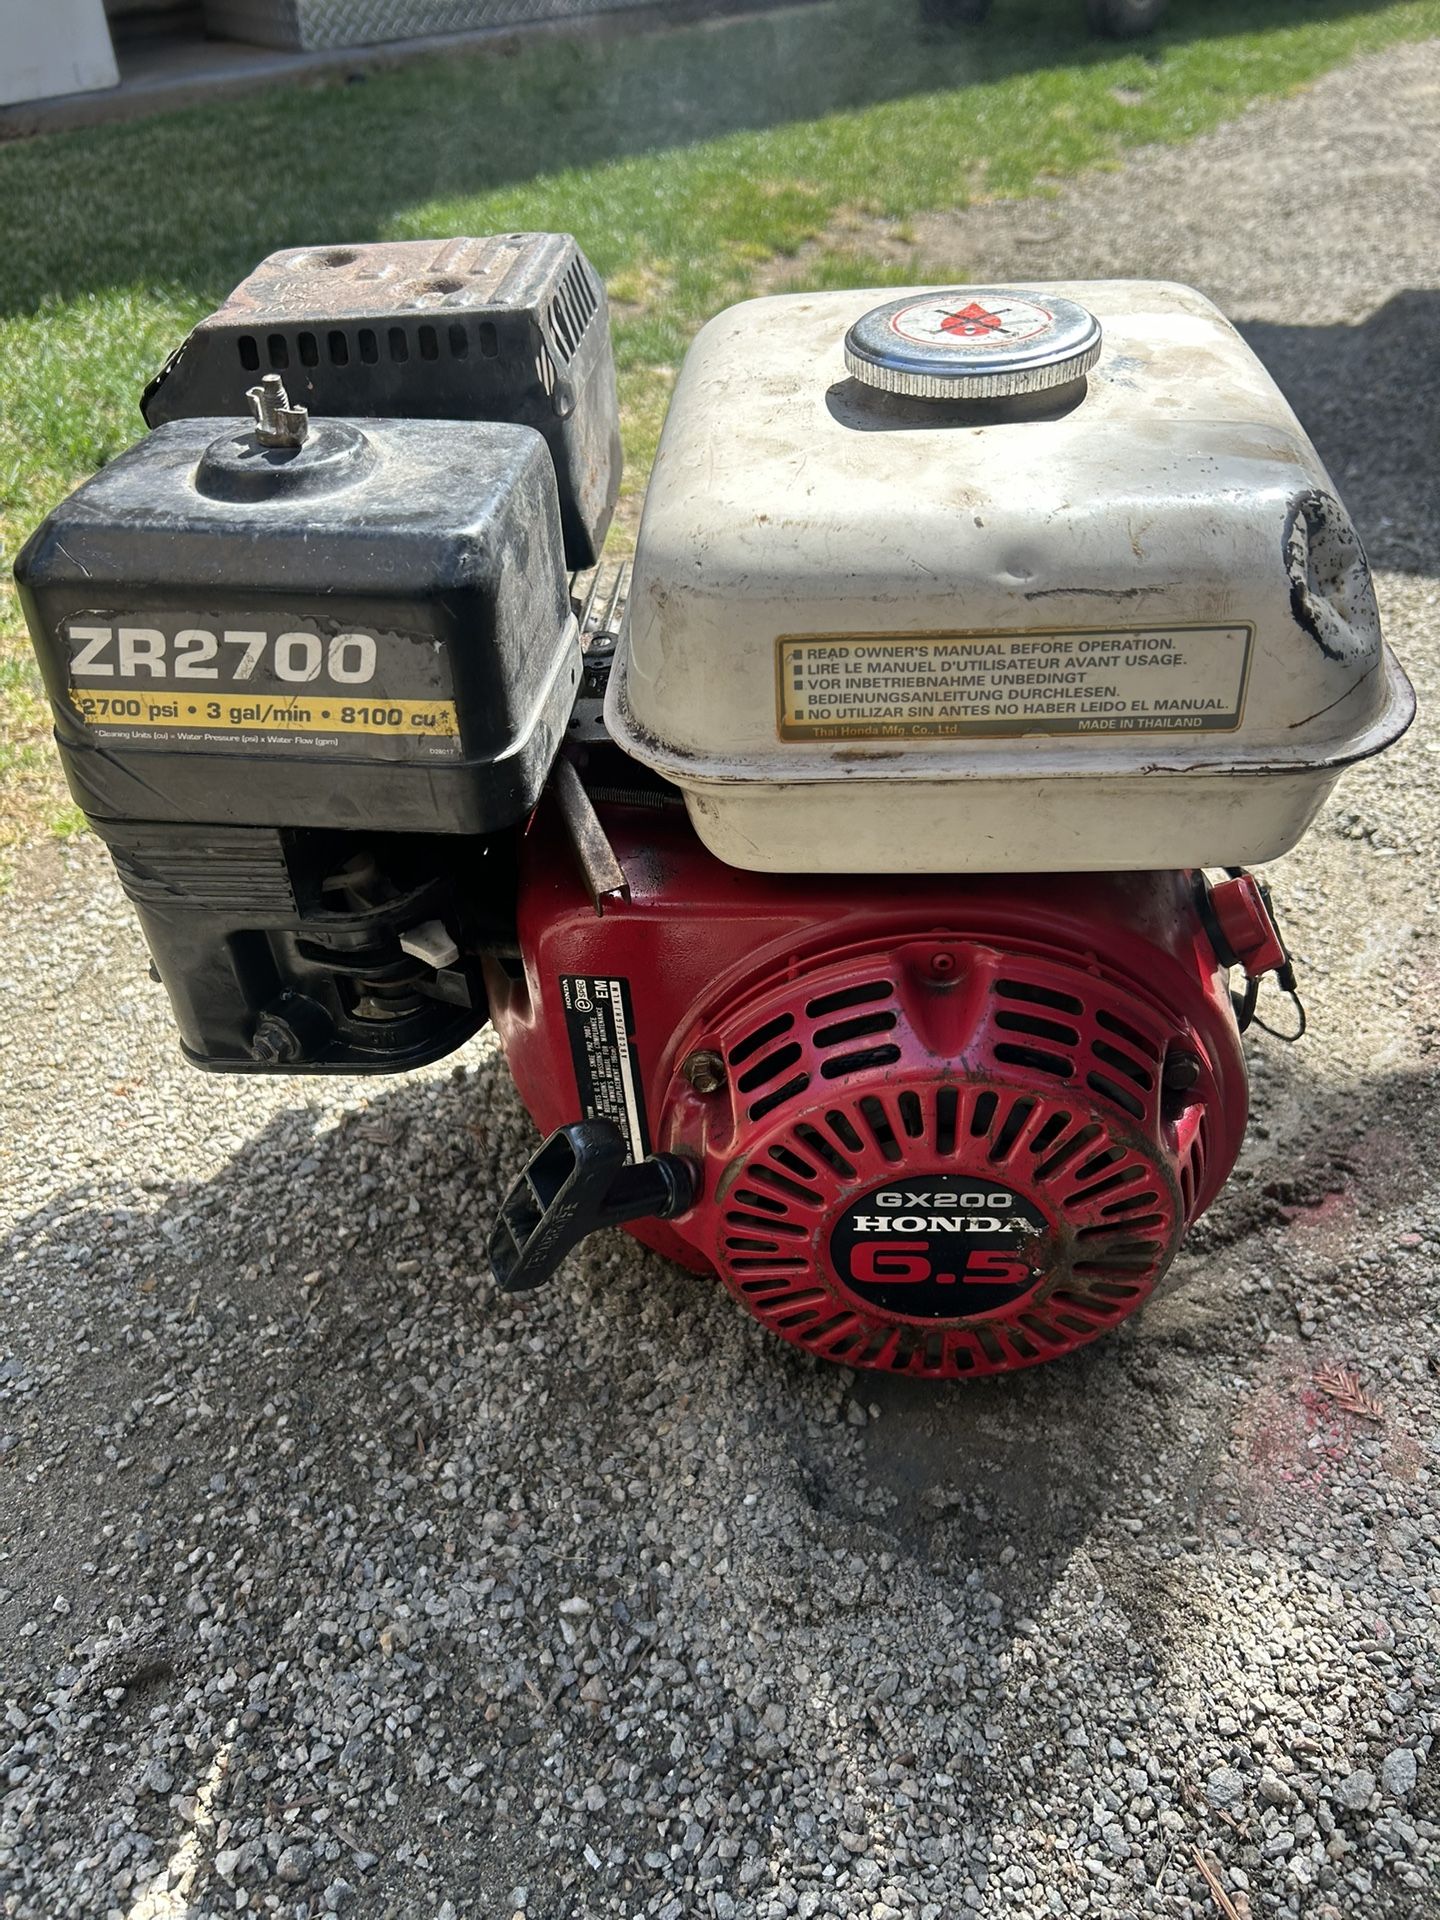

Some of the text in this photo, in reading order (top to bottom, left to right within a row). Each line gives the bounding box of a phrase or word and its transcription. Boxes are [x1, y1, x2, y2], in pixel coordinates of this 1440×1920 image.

[69, 626, 376, 684] ZR2700
[807, 638, 1176, 660] READ OWNER'S MANUAL BEFORE OPERATION.
[808, 654, 1187, 676] LIRE LE MANUEL D'UTILISATEUR AVANT USAGE.
[808, 672, 1087, 690] VOR INBETRIEBNAHME UNBEDINGT
[808, 686, 1120, 705] BEDIENUNGSANLEITUNG DURCHLESEN.
[82, 699, 141, 716] 2700
[149, 701, 179, 721] psi
[207, 702, 221, 719] 3
[230, 704, 311, 724] gal/min
[341, 707, 403, 726] 8100
[809, 699, 1229, 720] NO UTILIZAR SIN ANTES NO HABER LEIDO EL MANUAL.
[812, 724, 960, 736] Thai Honda Mfg. Co., Ltd.
[1078, 717, 1202, 730] MADE IN THAILAND
[132, 731, 152, 739] Units
[154, 732, 168, 740] (cu)
[178, 732, 203, 740] Water
[205, 733, 240, 742] Pressure
[242, 735, 258, 743] (psi)
[267, 736, 292, 744] Water
[295, 736, 313, 744] Flow
[315, 737, 338, 746] (gpm)
[562, 979, 572, 1009] HONDA
[577, 981, 586, 997] SPEC
[594, 980, 608, 999] EM
[590, 1017, 601, 1049] COMPLIANCE
[596, 1006, 607, 1042] MAINTENANCE
[596, 1052, 606, 1078] EMISSIONS
[604, 1058, 613, 1078] MANUAL
[601, 1081, 610, 1113] REGULATIONS.
[607, 1081, 616, 1102] OWNER'S
[595, 1095, 603, 1110] MEETS
[619, 1106, 629, 1138] ADJUSTMENTS.
[876, 1192, 1013, 1208] GX200
[852, 1215, 1043, 1237] HONDA
[850, 1241, 1030, 1284] 6.5
